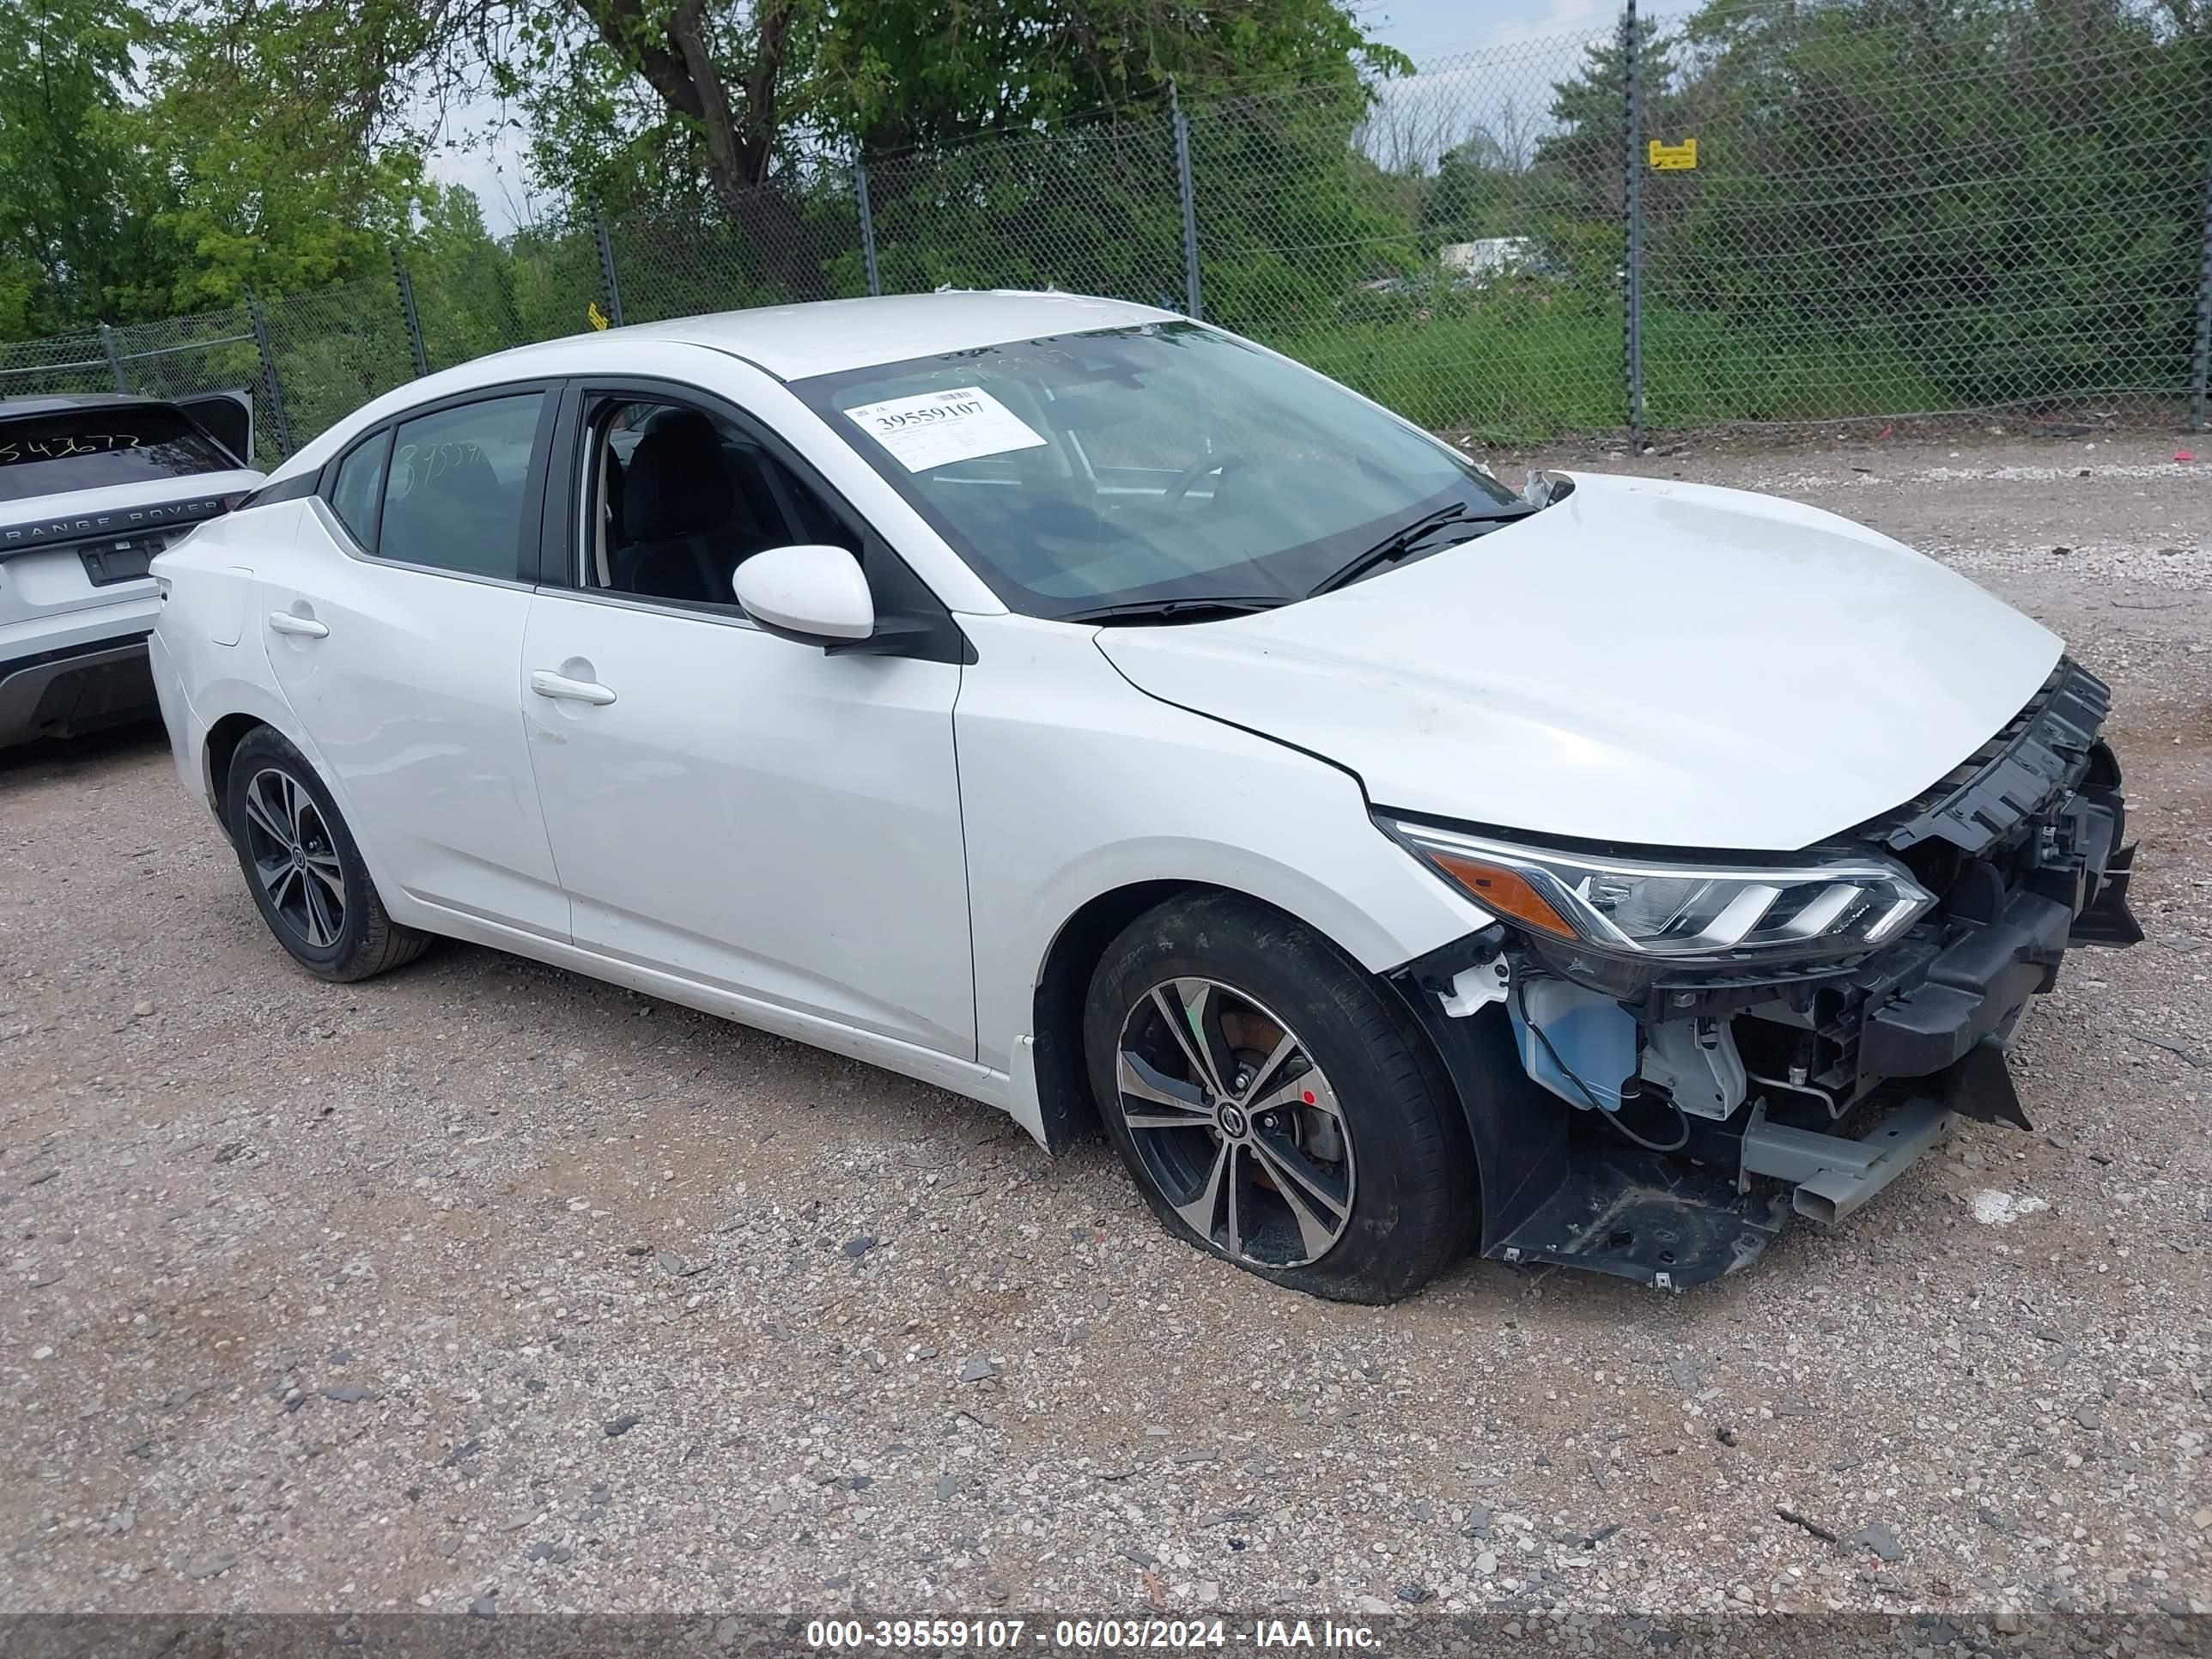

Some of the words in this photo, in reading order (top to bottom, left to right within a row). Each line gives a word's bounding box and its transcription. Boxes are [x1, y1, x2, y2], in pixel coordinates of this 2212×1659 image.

[876, 400, 984, 430] 39559107
[5, 517, 110, 541] RANGE
[129, 501, 218, 522] ROVER
